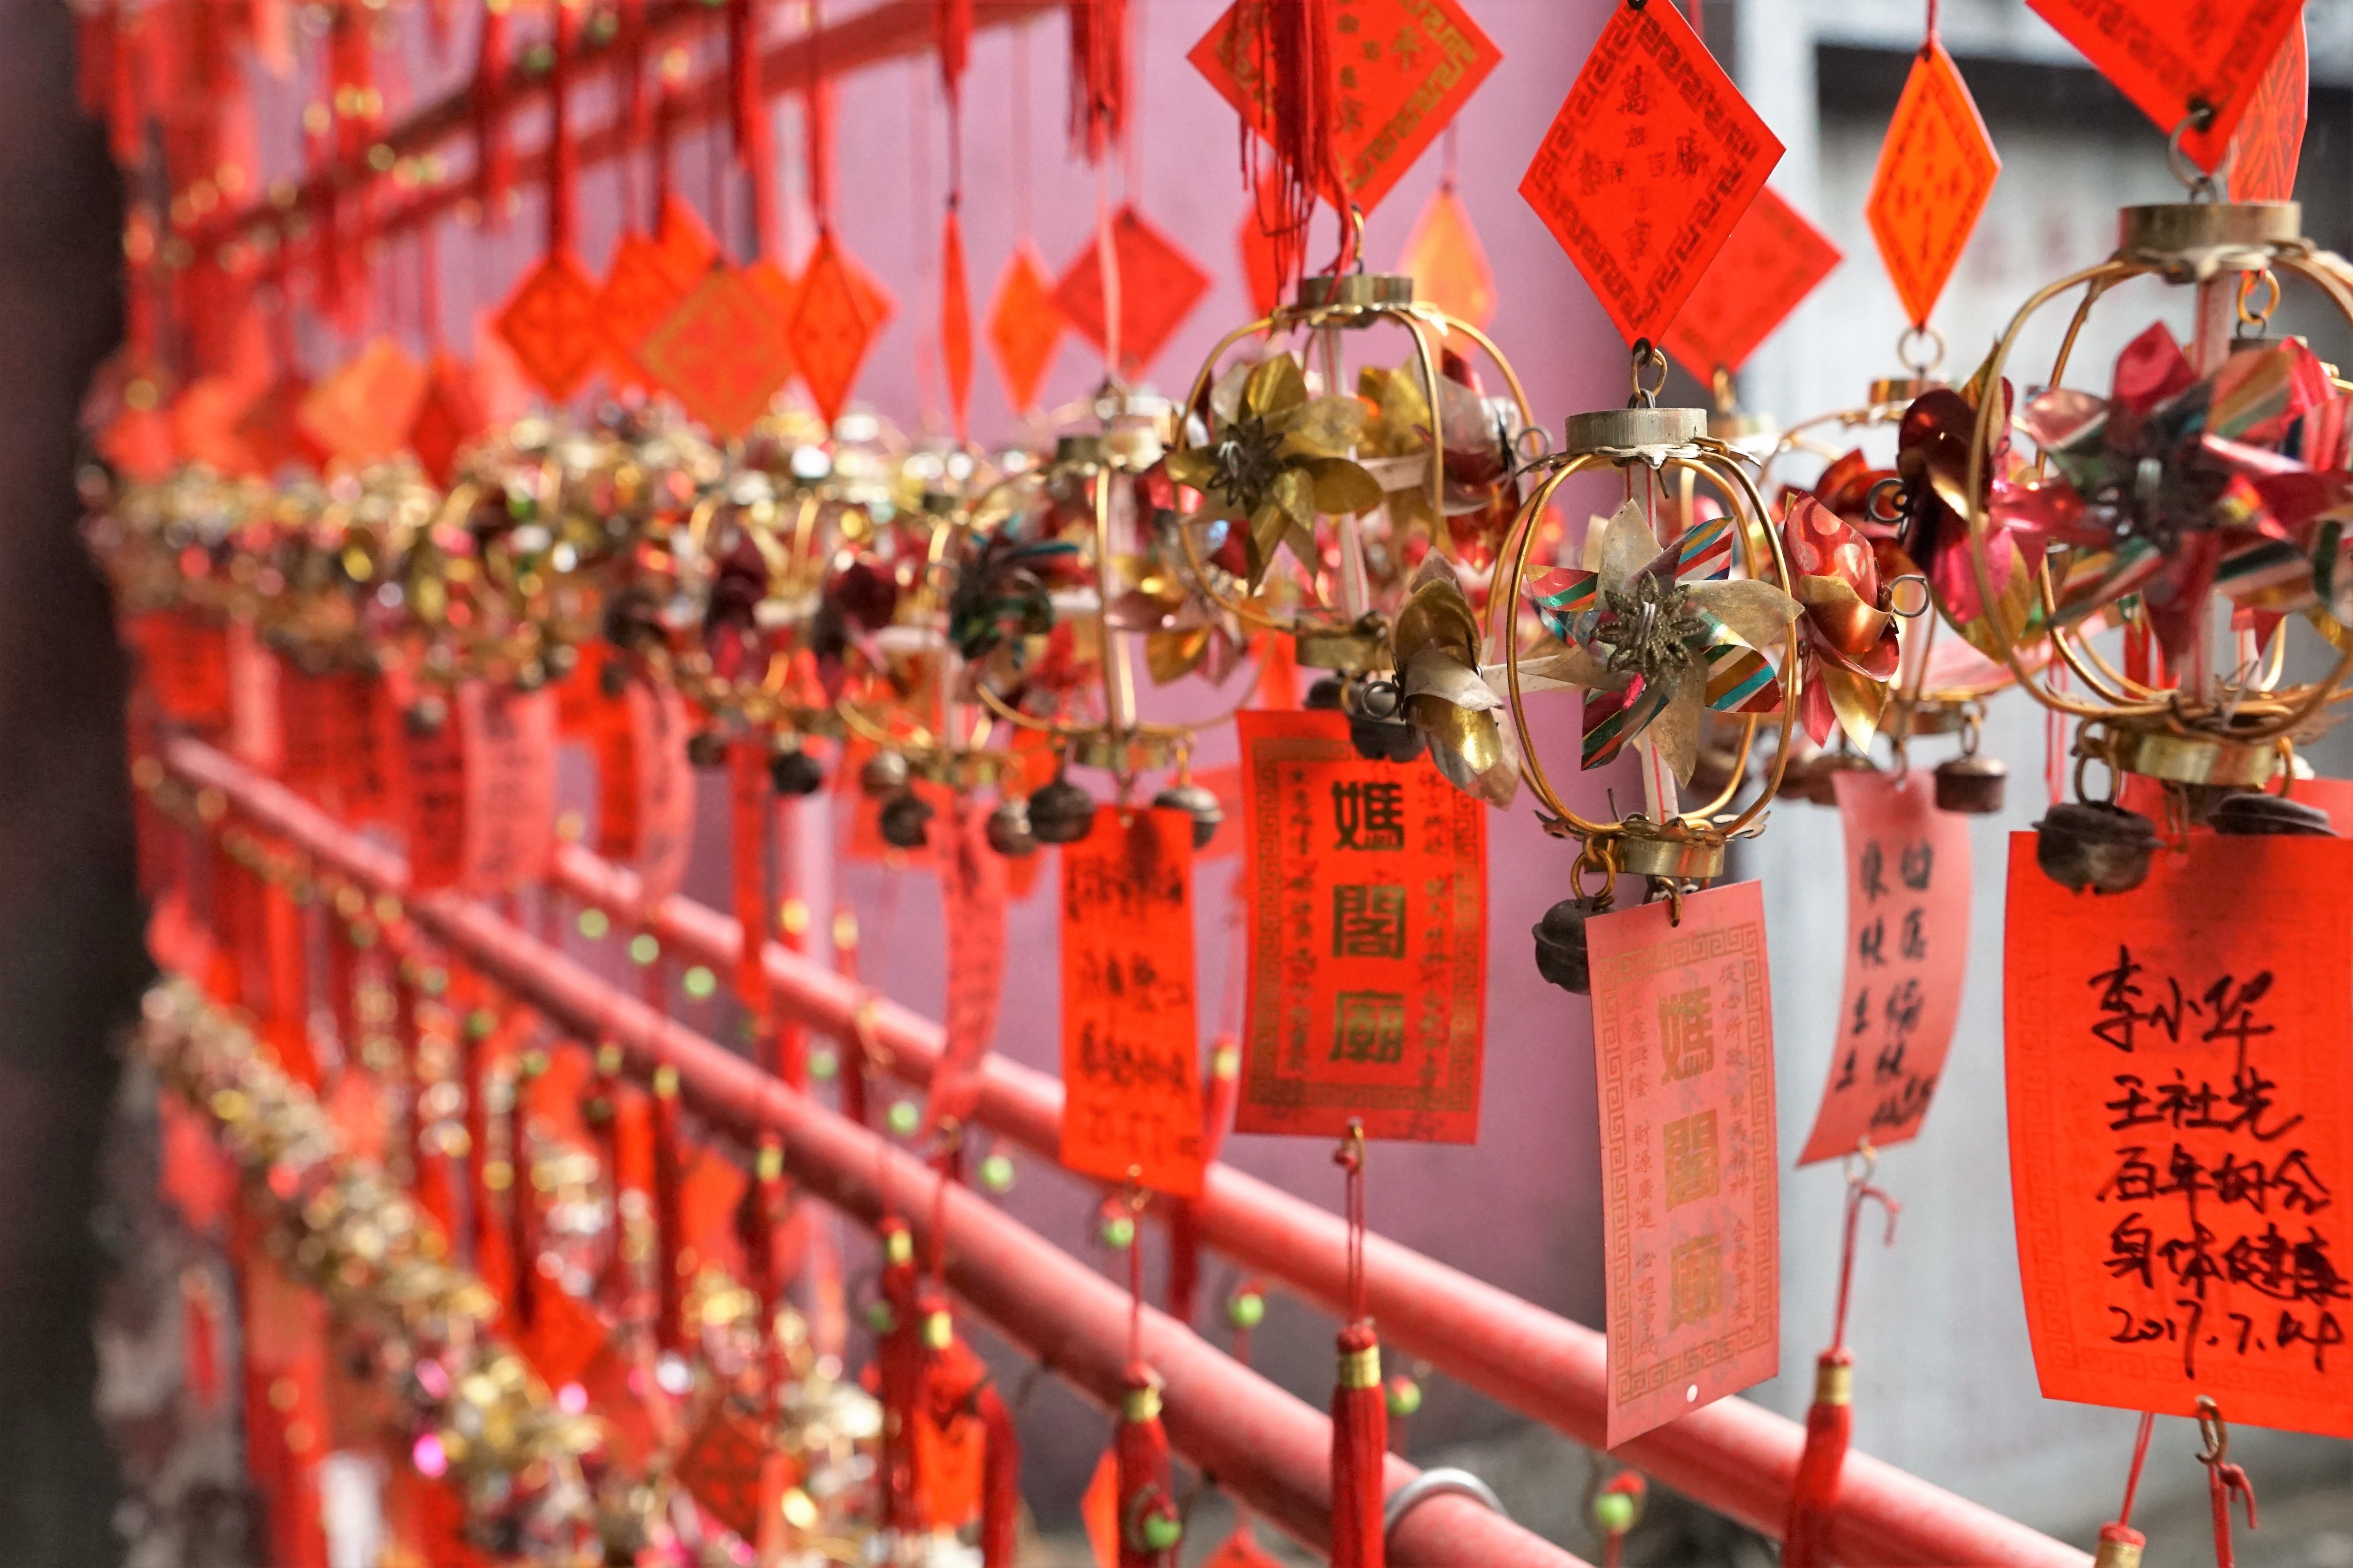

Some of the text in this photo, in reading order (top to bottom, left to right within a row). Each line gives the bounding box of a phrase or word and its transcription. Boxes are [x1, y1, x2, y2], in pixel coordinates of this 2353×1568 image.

[1328, 780, 1408, 1064] 媽閣廟
[1658, 985, 1722, 1333] 媽閣廟
